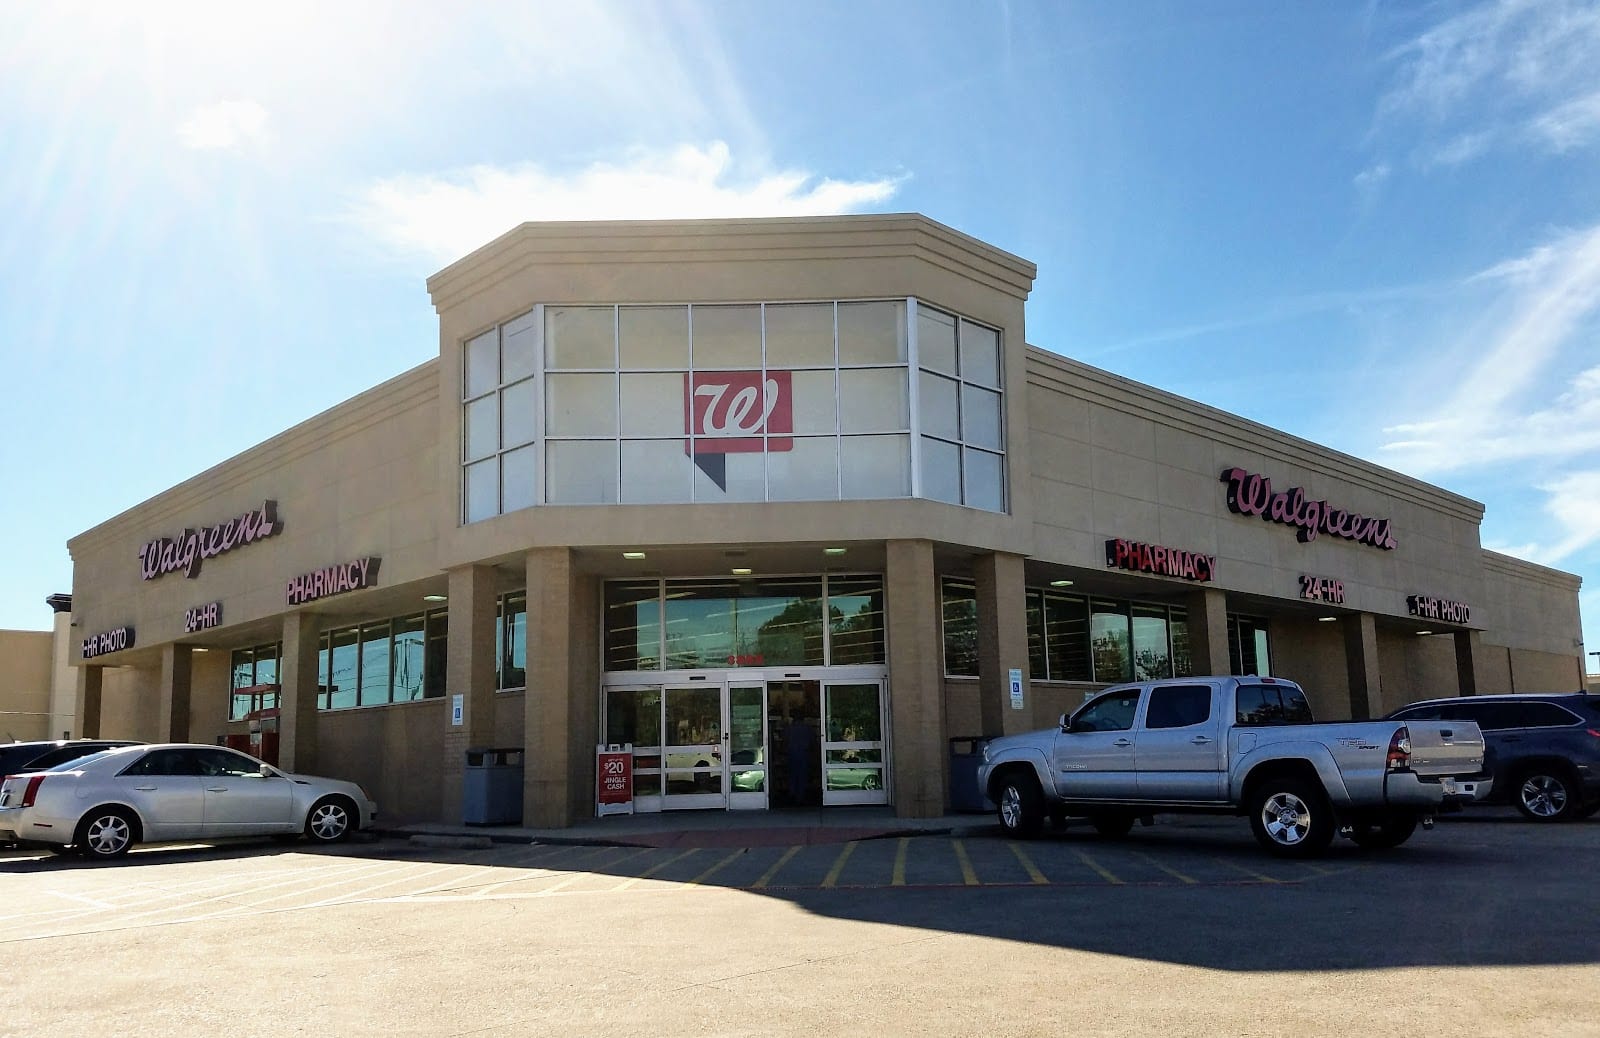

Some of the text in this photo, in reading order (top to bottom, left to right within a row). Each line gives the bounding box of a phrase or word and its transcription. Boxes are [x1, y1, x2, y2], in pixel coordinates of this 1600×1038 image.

[1230, 467, 1398, 551] Walgreens
[139, 499, 274, 580] Walgreens
[1116, 539, 1217, 582] PHARMACY
[286, 557, 370, 605] PHARMACY
[1303, 575, 1346, 604] 24-HR
[184, 602, 218, 633] 24-HR
[1414, 596, 1471, 624] 1-HR PHOTO
[99, 627, 127, 654] PHOTO
[604, 762, 624, 774] $20
